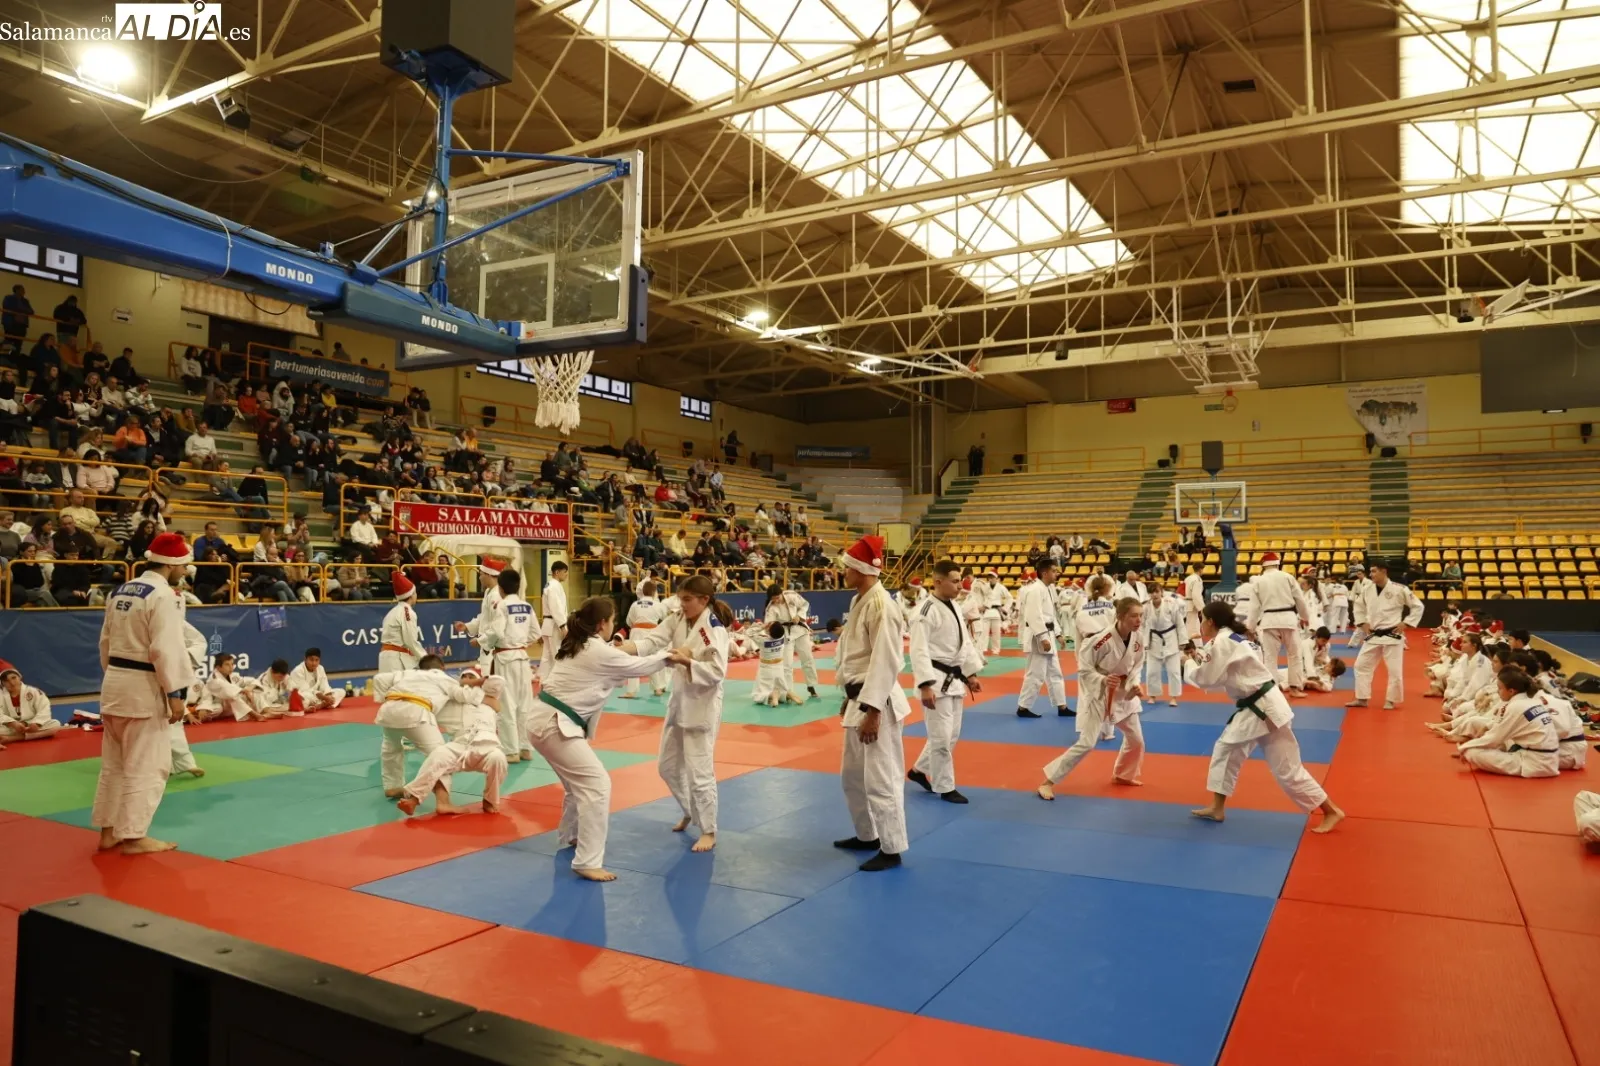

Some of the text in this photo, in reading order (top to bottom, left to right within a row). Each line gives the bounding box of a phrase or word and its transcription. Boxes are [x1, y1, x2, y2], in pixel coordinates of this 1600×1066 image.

[265, 262, 314, 285] MONDO
[421, 314, 459, 335] MONDO
[438, 507, 553, 527] SALAMANCA
[418, 521, 566, 539] PATRIMONIO DE LA HUMANIDAD
[115, 600, 133, 612] ES
[734, 605, 756, 621] LEÓN
[1088, 608, 1105, 617] UKR
[432, 623, 445, 644] Y
